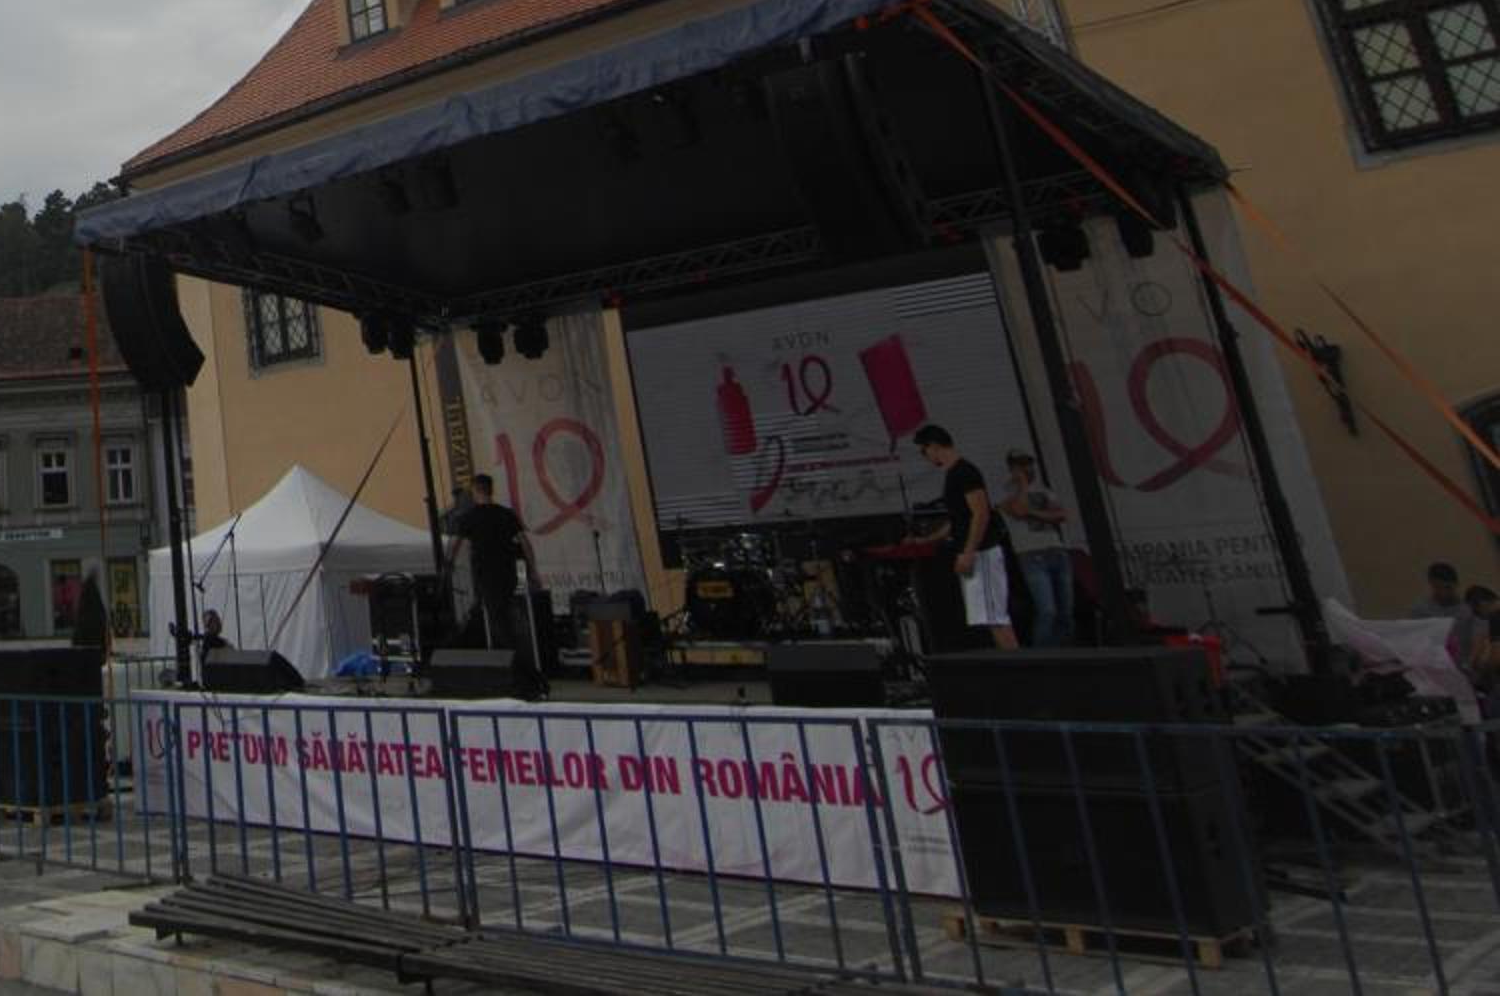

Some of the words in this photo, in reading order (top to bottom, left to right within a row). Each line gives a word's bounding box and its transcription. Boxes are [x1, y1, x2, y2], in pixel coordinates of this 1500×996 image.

[296, 731, 449, 779] SĂNĂTATEA
[452, 747, 609, 791] FEMEILOR
[618, 754, 682, 795] DIN
[691, 752, 886, 808] ROMÂNIA
